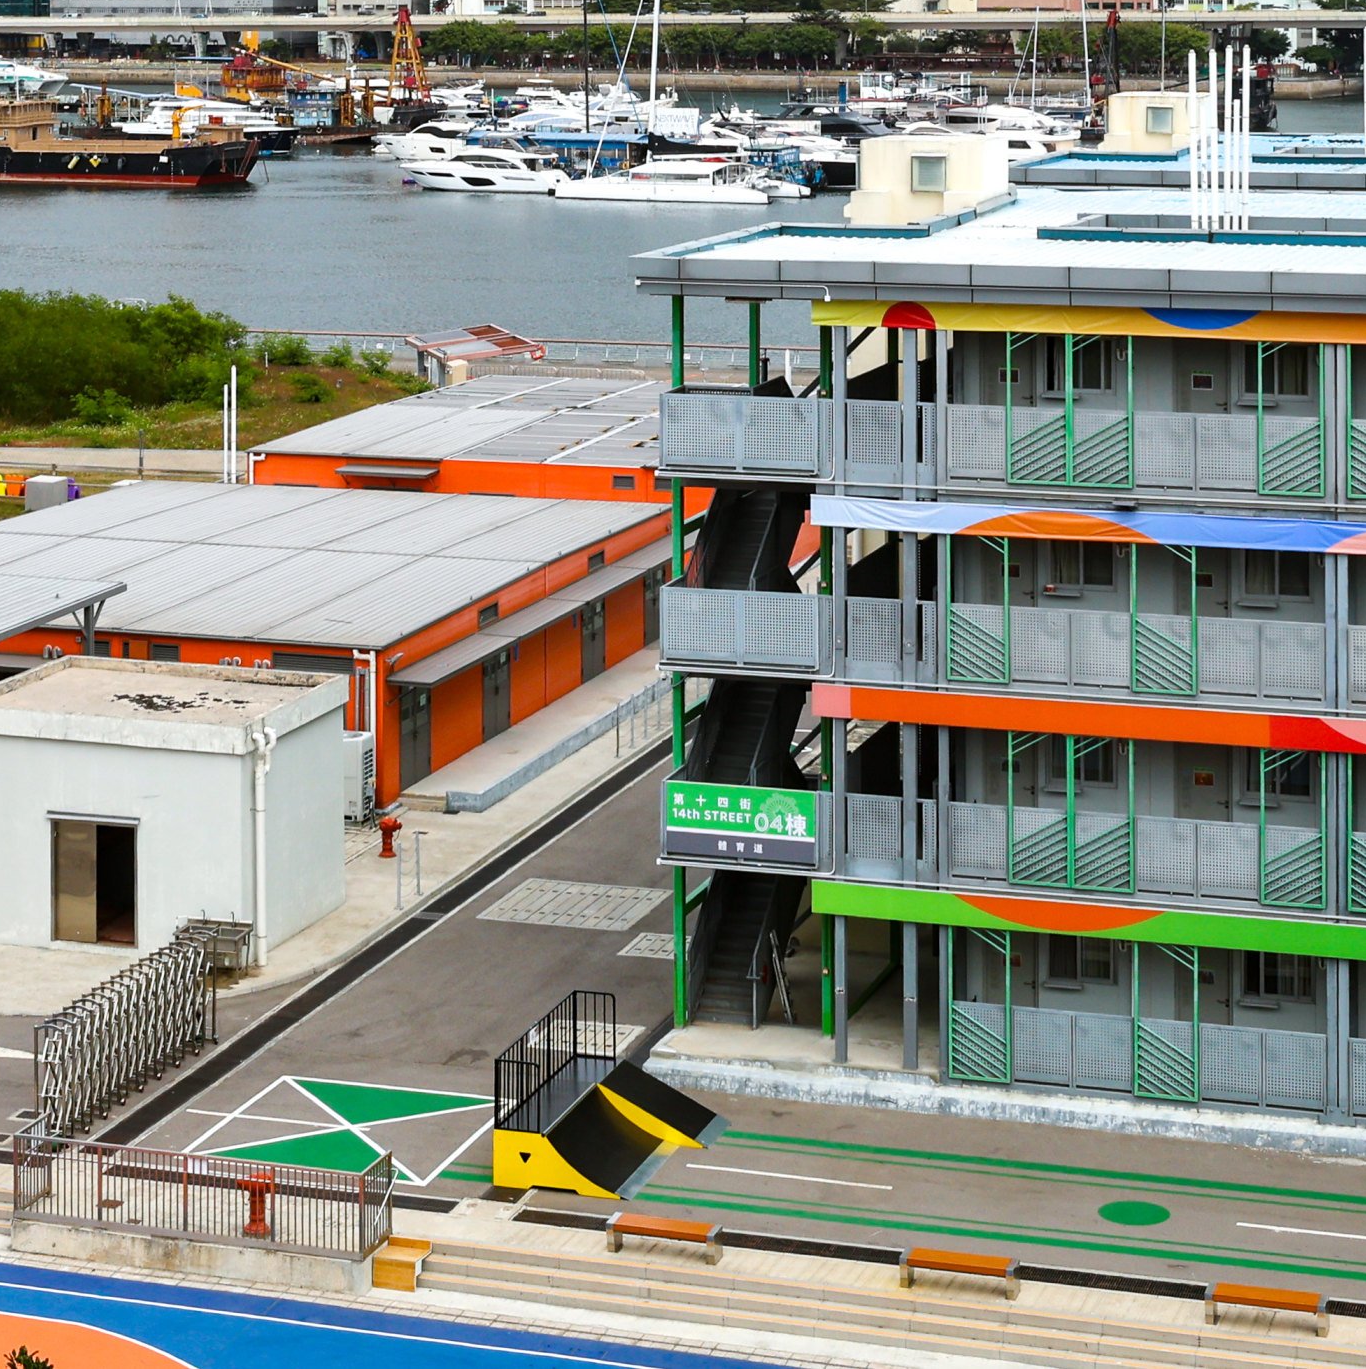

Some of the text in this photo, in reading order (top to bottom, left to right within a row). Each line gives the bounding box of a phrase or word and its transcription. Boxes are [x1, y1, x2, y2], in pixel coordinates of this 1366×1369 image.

[673, 793, 751, 810] 第十四街
[672, 807, 752, 824] 14th STREET
[754, 812, 807, 836] 04棟
[717, 840, 764, 854] 體育道
